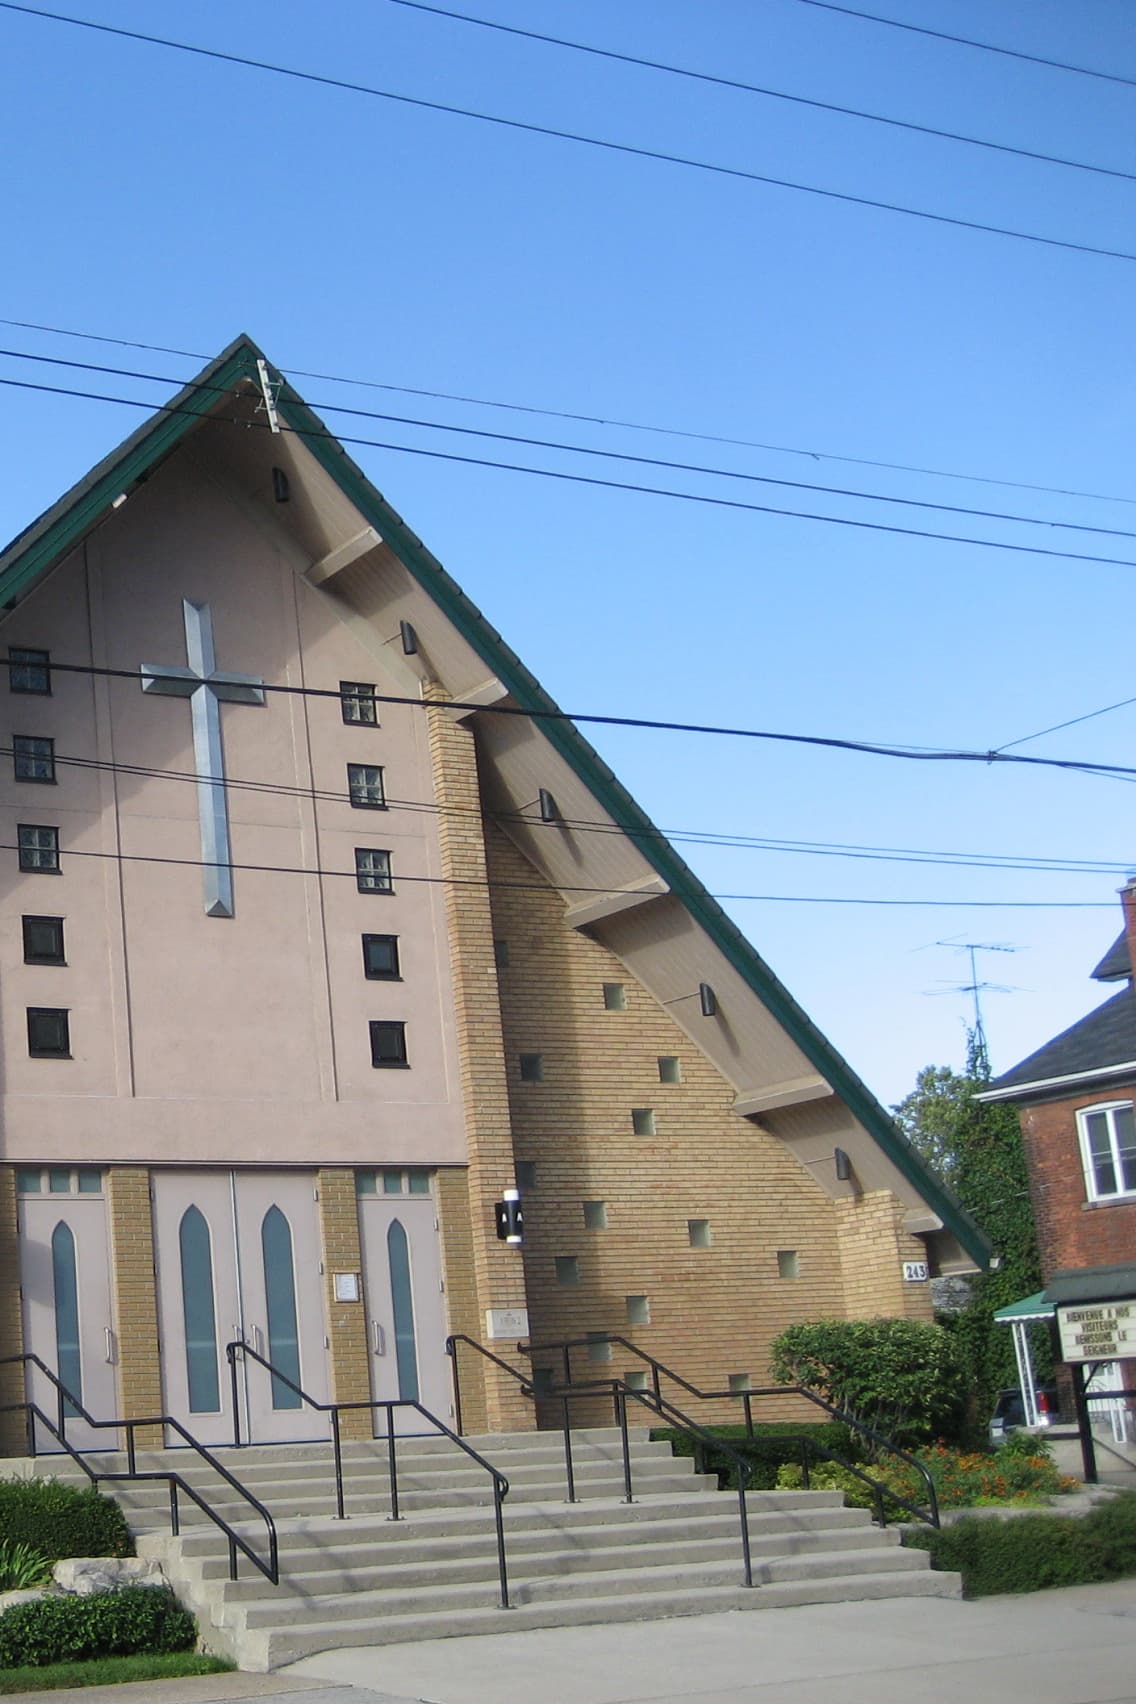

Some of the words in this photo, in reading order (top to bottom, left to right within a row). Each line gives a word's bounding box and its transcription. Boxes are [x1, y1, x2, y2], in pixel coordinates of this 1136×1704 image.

[906, 1266, 925, 1278] 243
[1066, 1310, 1103, 1322] BIENVENUE
[1081, 1320, 1118, 1332] VISITEURS
[1118, 1330, 1127, 1341] LE
